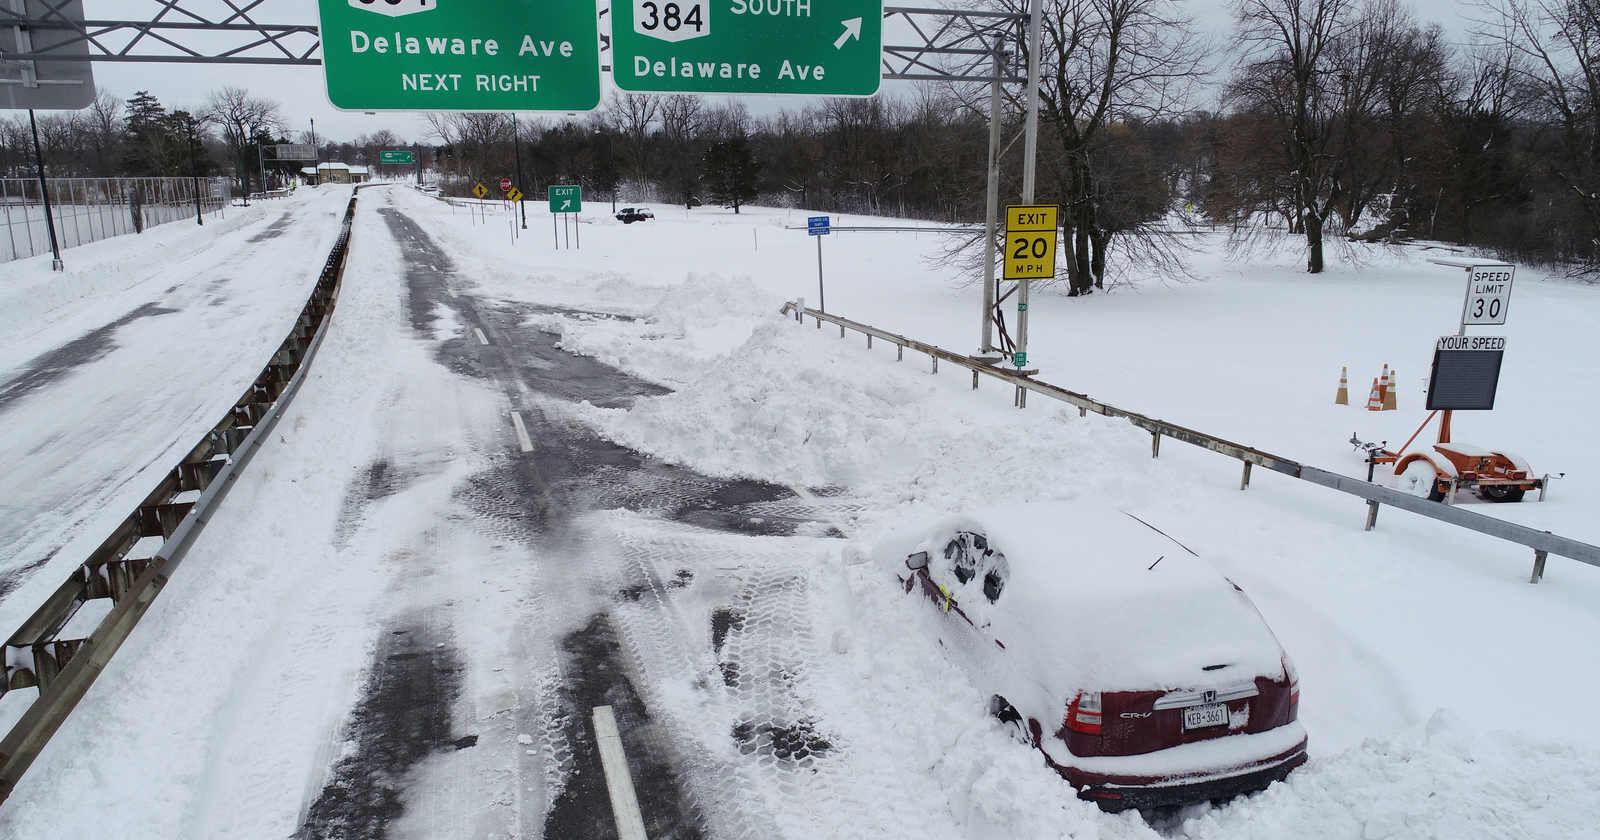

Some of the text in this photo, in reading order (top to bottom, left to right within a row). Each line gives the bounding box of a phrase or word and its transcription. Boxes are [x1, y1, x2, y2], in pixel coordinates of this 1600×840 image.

[730, 0, 811, 16] SOUTH
[641, 2, 703, 32] 384
[350, 31, 574, 57] Delaware Ave
[634, 56, 825, 80] Delaware Ave
[402, 73, 541, 92] NEXT RIGHT
[555, 188, 574, 196] EXIT
[1018, 213, 1047, 225] EXIT
[1013, 238, 1047, 259] 20
[1016, 265, 1042, 273] MPH
[1474, 272, 1510, 282] SPEED
[1475, 285, 1504, 294] LIMIT
[1473, 298, 1501, 318] 30
[1441, 337, 1505, 349] YOUR SPEED
